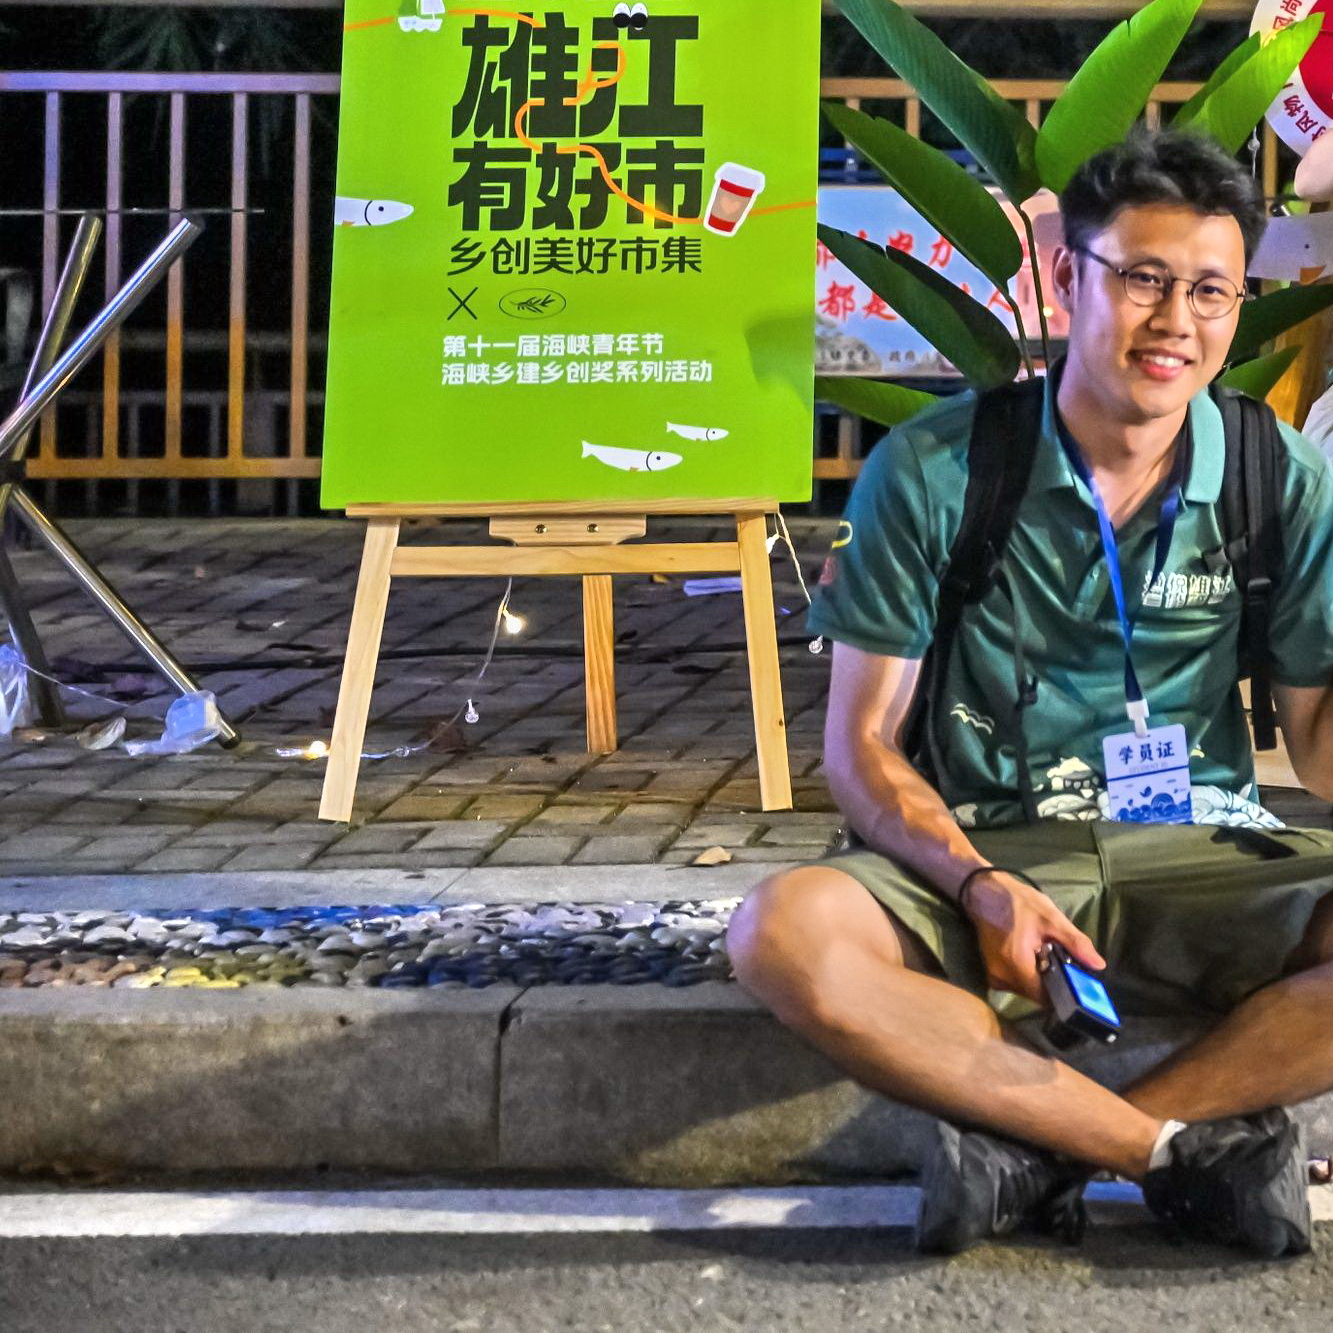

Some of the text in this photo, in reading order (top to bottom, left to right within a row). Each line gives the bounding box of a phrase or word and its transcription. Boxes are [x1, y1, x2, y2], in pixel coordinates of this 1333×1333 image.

[451, 11, 703, 139] 雄江
[447, 139, 705, 232] 有好市
[447, 237, 702, 275] 乡创美好市集
[442, 334, 664, 359] 第十一届海峡青年节
[441, 360, 713, 386] 海峡乡建乡创奖系列活动
[1119, 741, 1175, 765] 学员证
